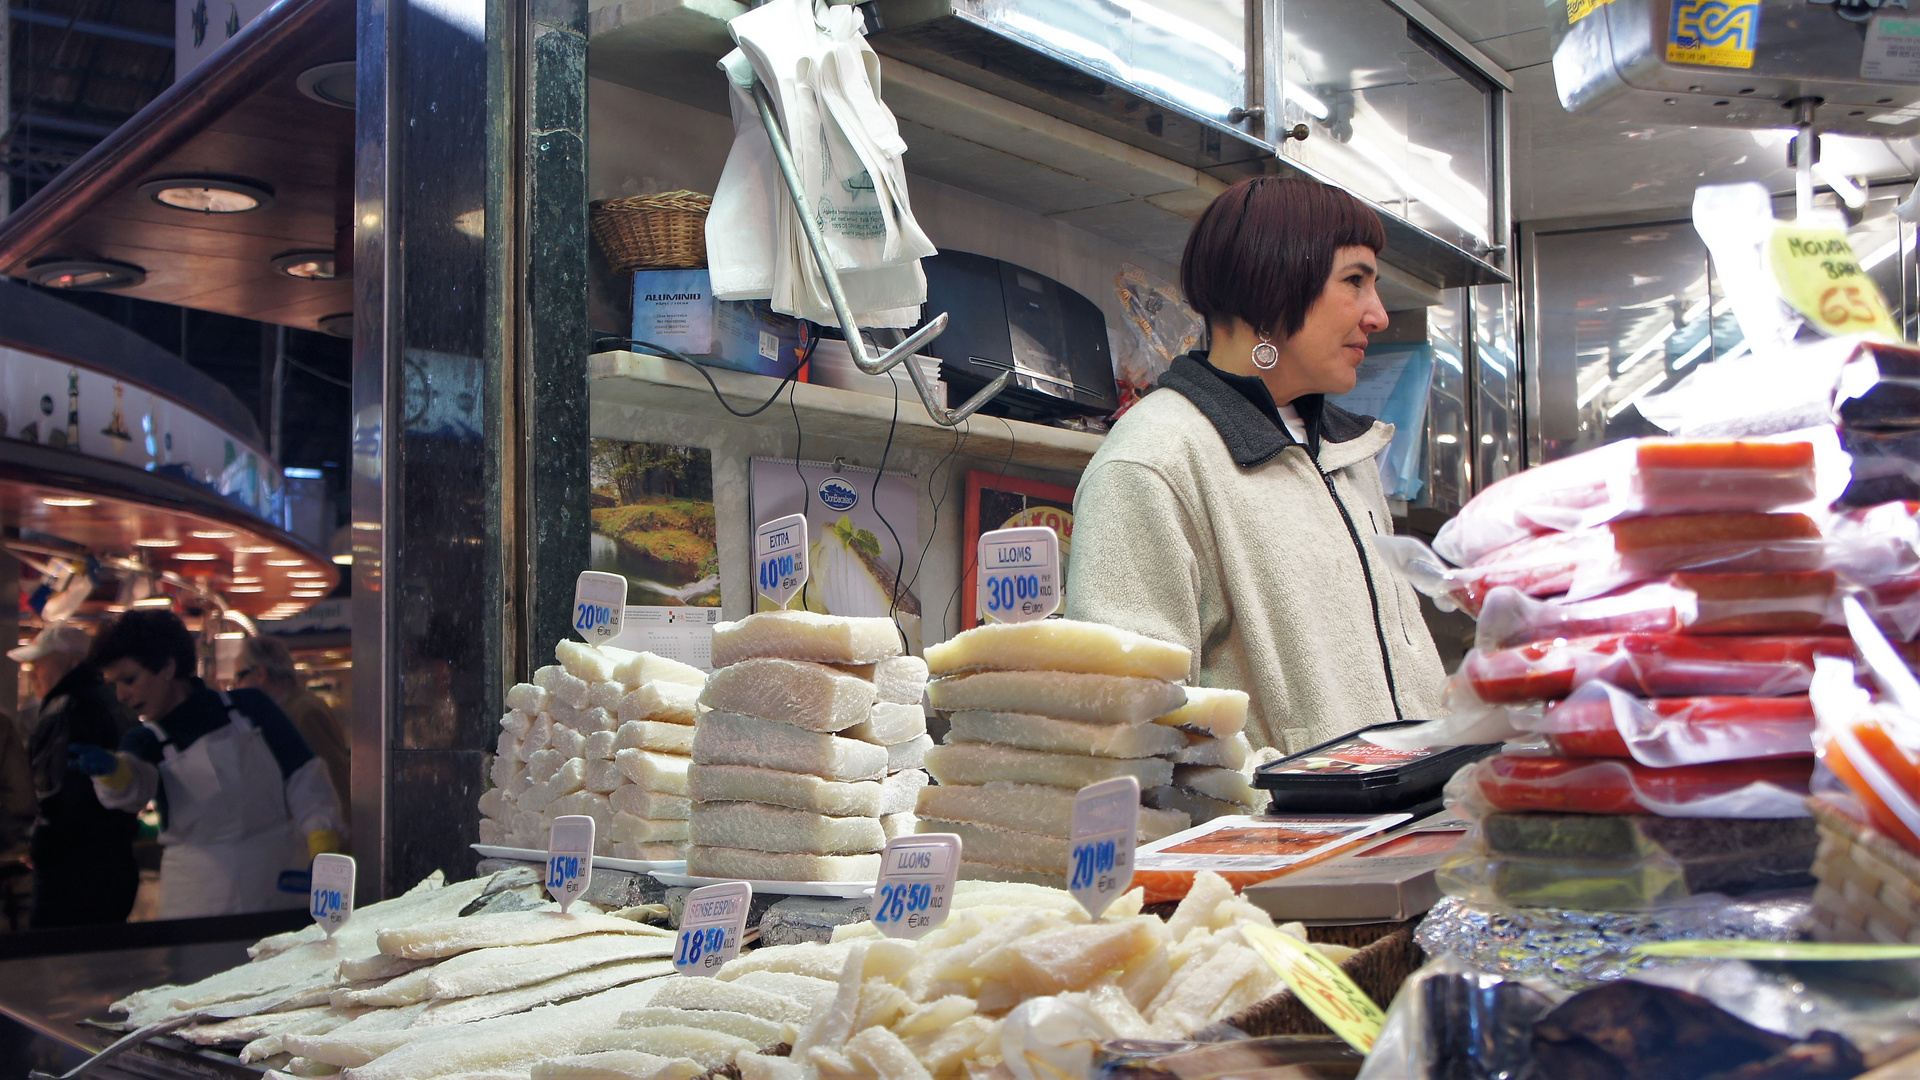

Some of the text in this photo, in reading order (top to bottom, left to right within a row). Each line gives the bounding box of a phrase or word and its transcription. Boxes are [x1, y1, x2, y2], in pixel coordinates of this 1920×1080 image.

[1677, 1, 1752, 50] ECA
[645, 293, 701, 301] ALUMINIO
[825, 493, 853, 505] DonBacalao
[769, 531, 789, 548] EXTRA
[998, 546, 1032, 562] LLOMS
[760, 554, 793, 590] 40'00
[987, 574, 1038, 611] 30'00
[576, 604, 610, 630] 20'00
[547, 856, 578, 888] 15'00
[897, 852, 932, 869] LLOMS
[1070, 839, 1116, 890] 20'00
[312, 889, 341, 917] 12'00
[690, 902, 714, 918] SENSE
[875, 884, 932, 922] 26'50
[676, 926, 725, 966] 18'50
